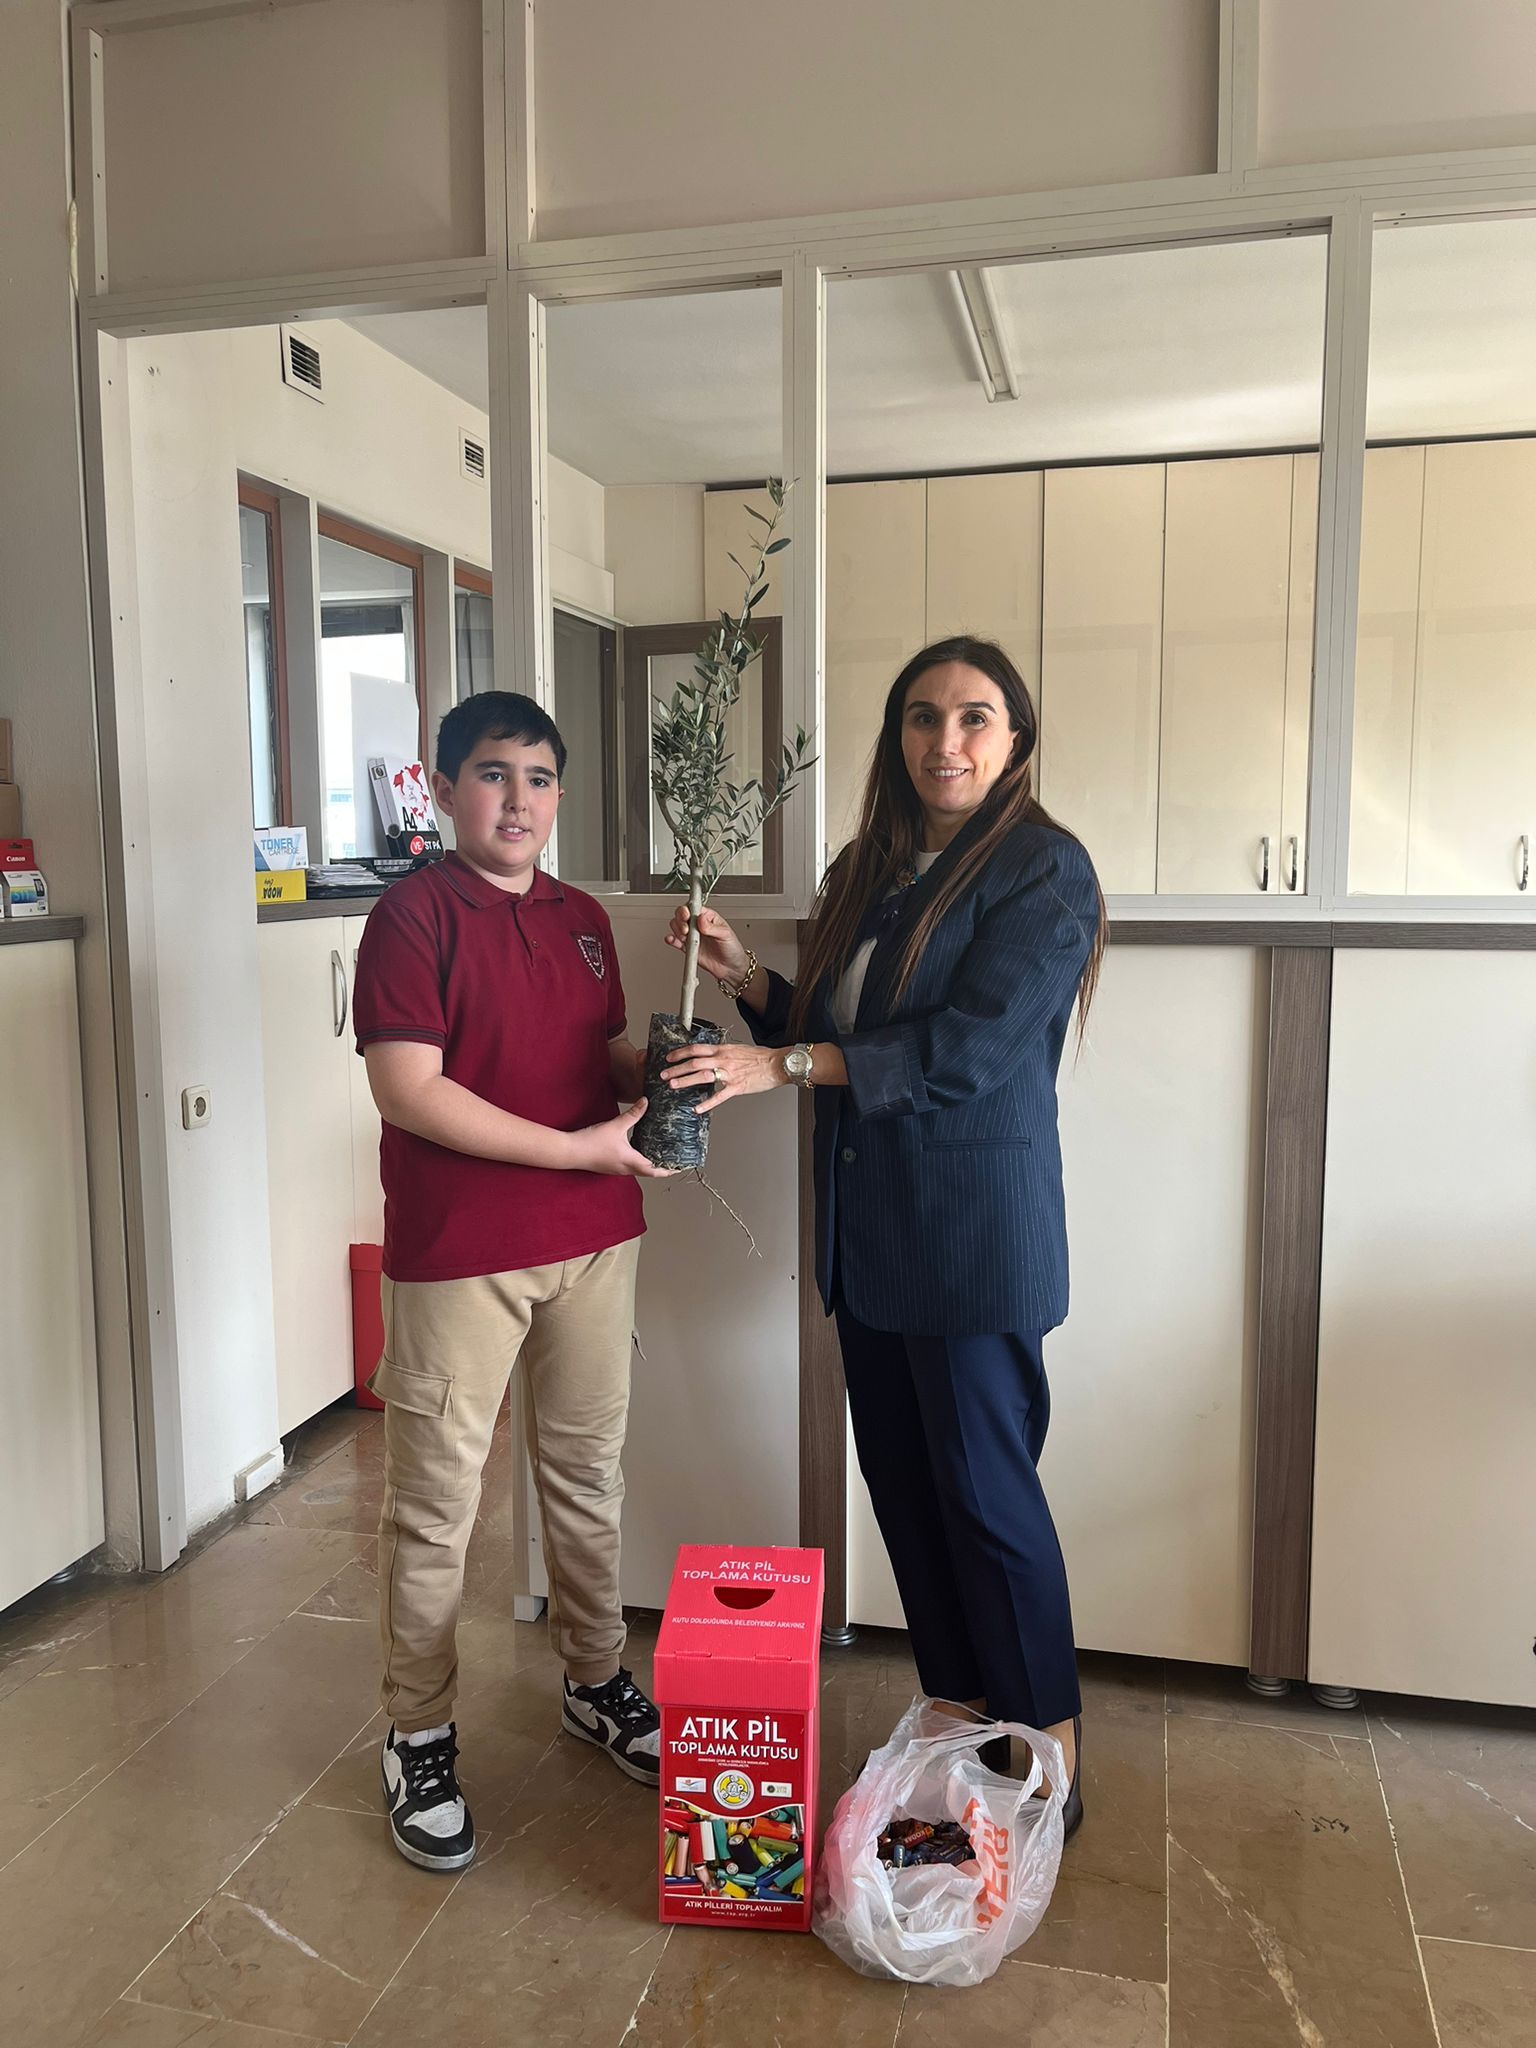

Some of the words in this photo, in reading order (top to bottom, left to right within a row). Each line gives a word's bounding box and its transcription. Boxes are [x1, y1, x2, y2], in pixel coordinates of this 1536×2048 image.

[402, 806, 418, 831] A4
[260, 837, 294, 850] TONER
[719, 1560, 751, 1570] ATIK
[754, 1560, 776, 1572] PİL
[682, 1570, 750, 1580] TOPLAMA
[752, 1572, 811, 1584] KUTUSU
[680, 1716, 739, 1741] ATIK
[748, 1715, 787, 1744] PİL
[669, 1741, 737, 1757] TOPLAMA
[740, 1744, 799, 1760] KUTUSU
[704, 1901, 733, 1910] PİLLERİ
[735, 1903, 783, 1912] TOPLAYALIM
